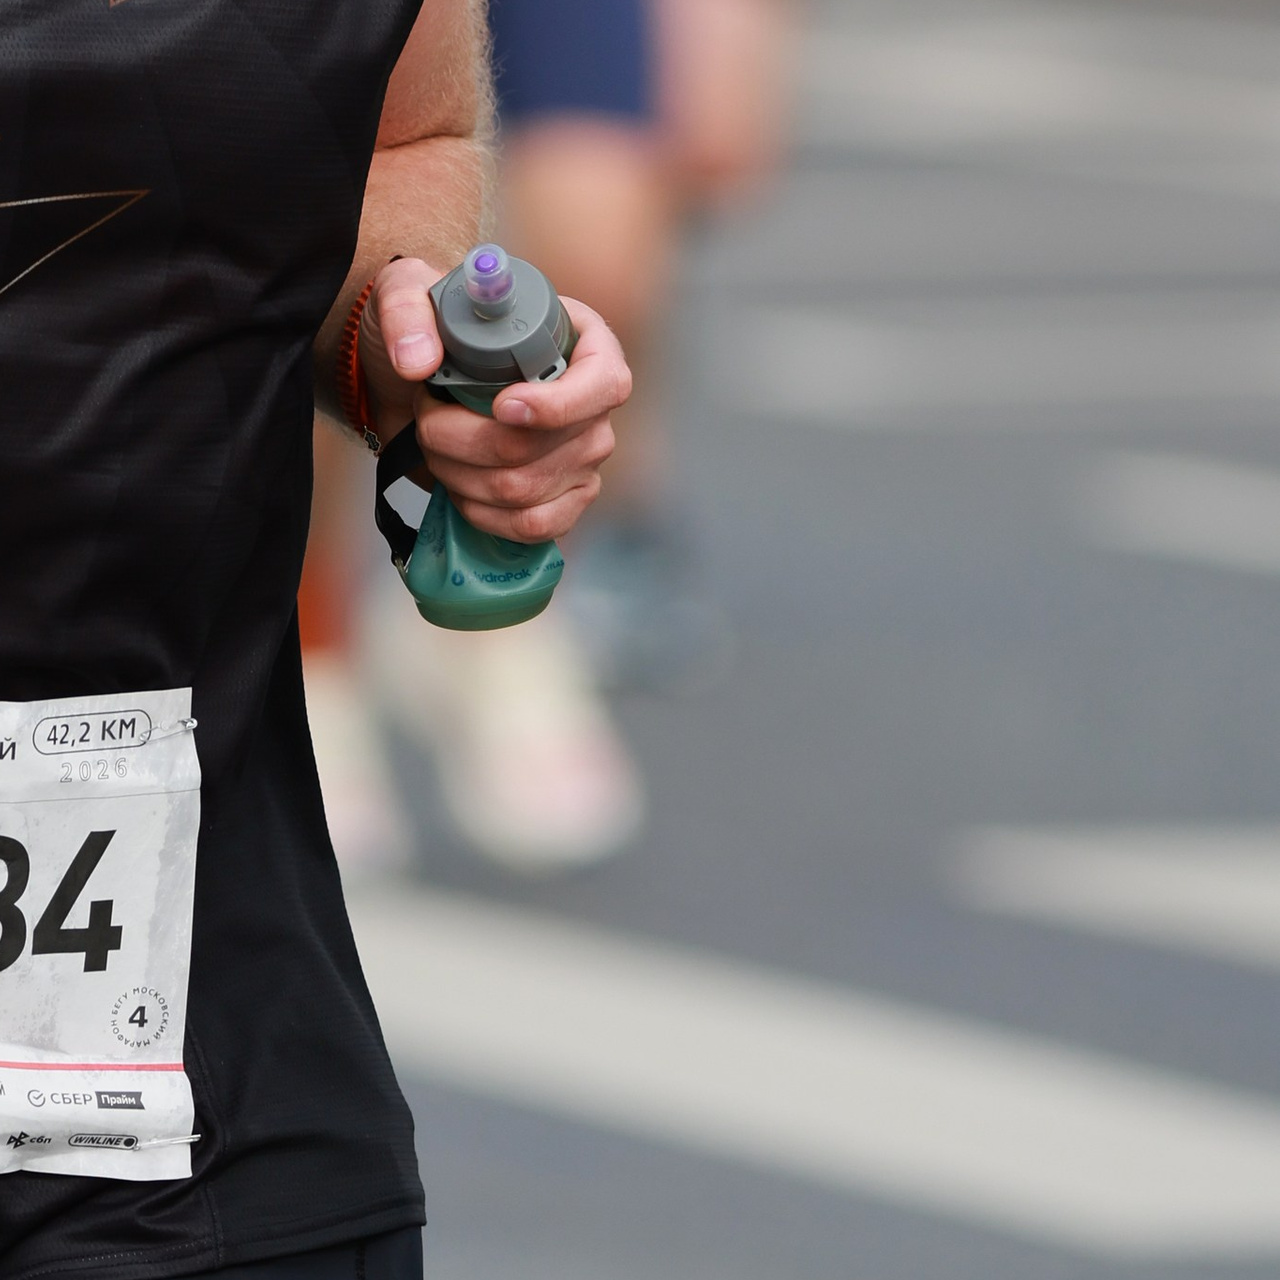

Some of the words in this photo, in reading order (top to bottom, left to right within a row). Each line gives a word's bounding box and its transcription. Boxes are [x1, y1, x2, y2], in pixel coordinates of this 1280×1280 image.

[472, 568, 532, 584] ydraPak
[46, 721, 91, 747] 42,2
[60, 757, 128, 784] 2026
[128, 1005, 148, 1028] 4
[50, 1093, 93, 1105] СБЕР
[100, 1094, 137, 1107] Прайм
[73, 1136, 123, 1146] WINLINE
